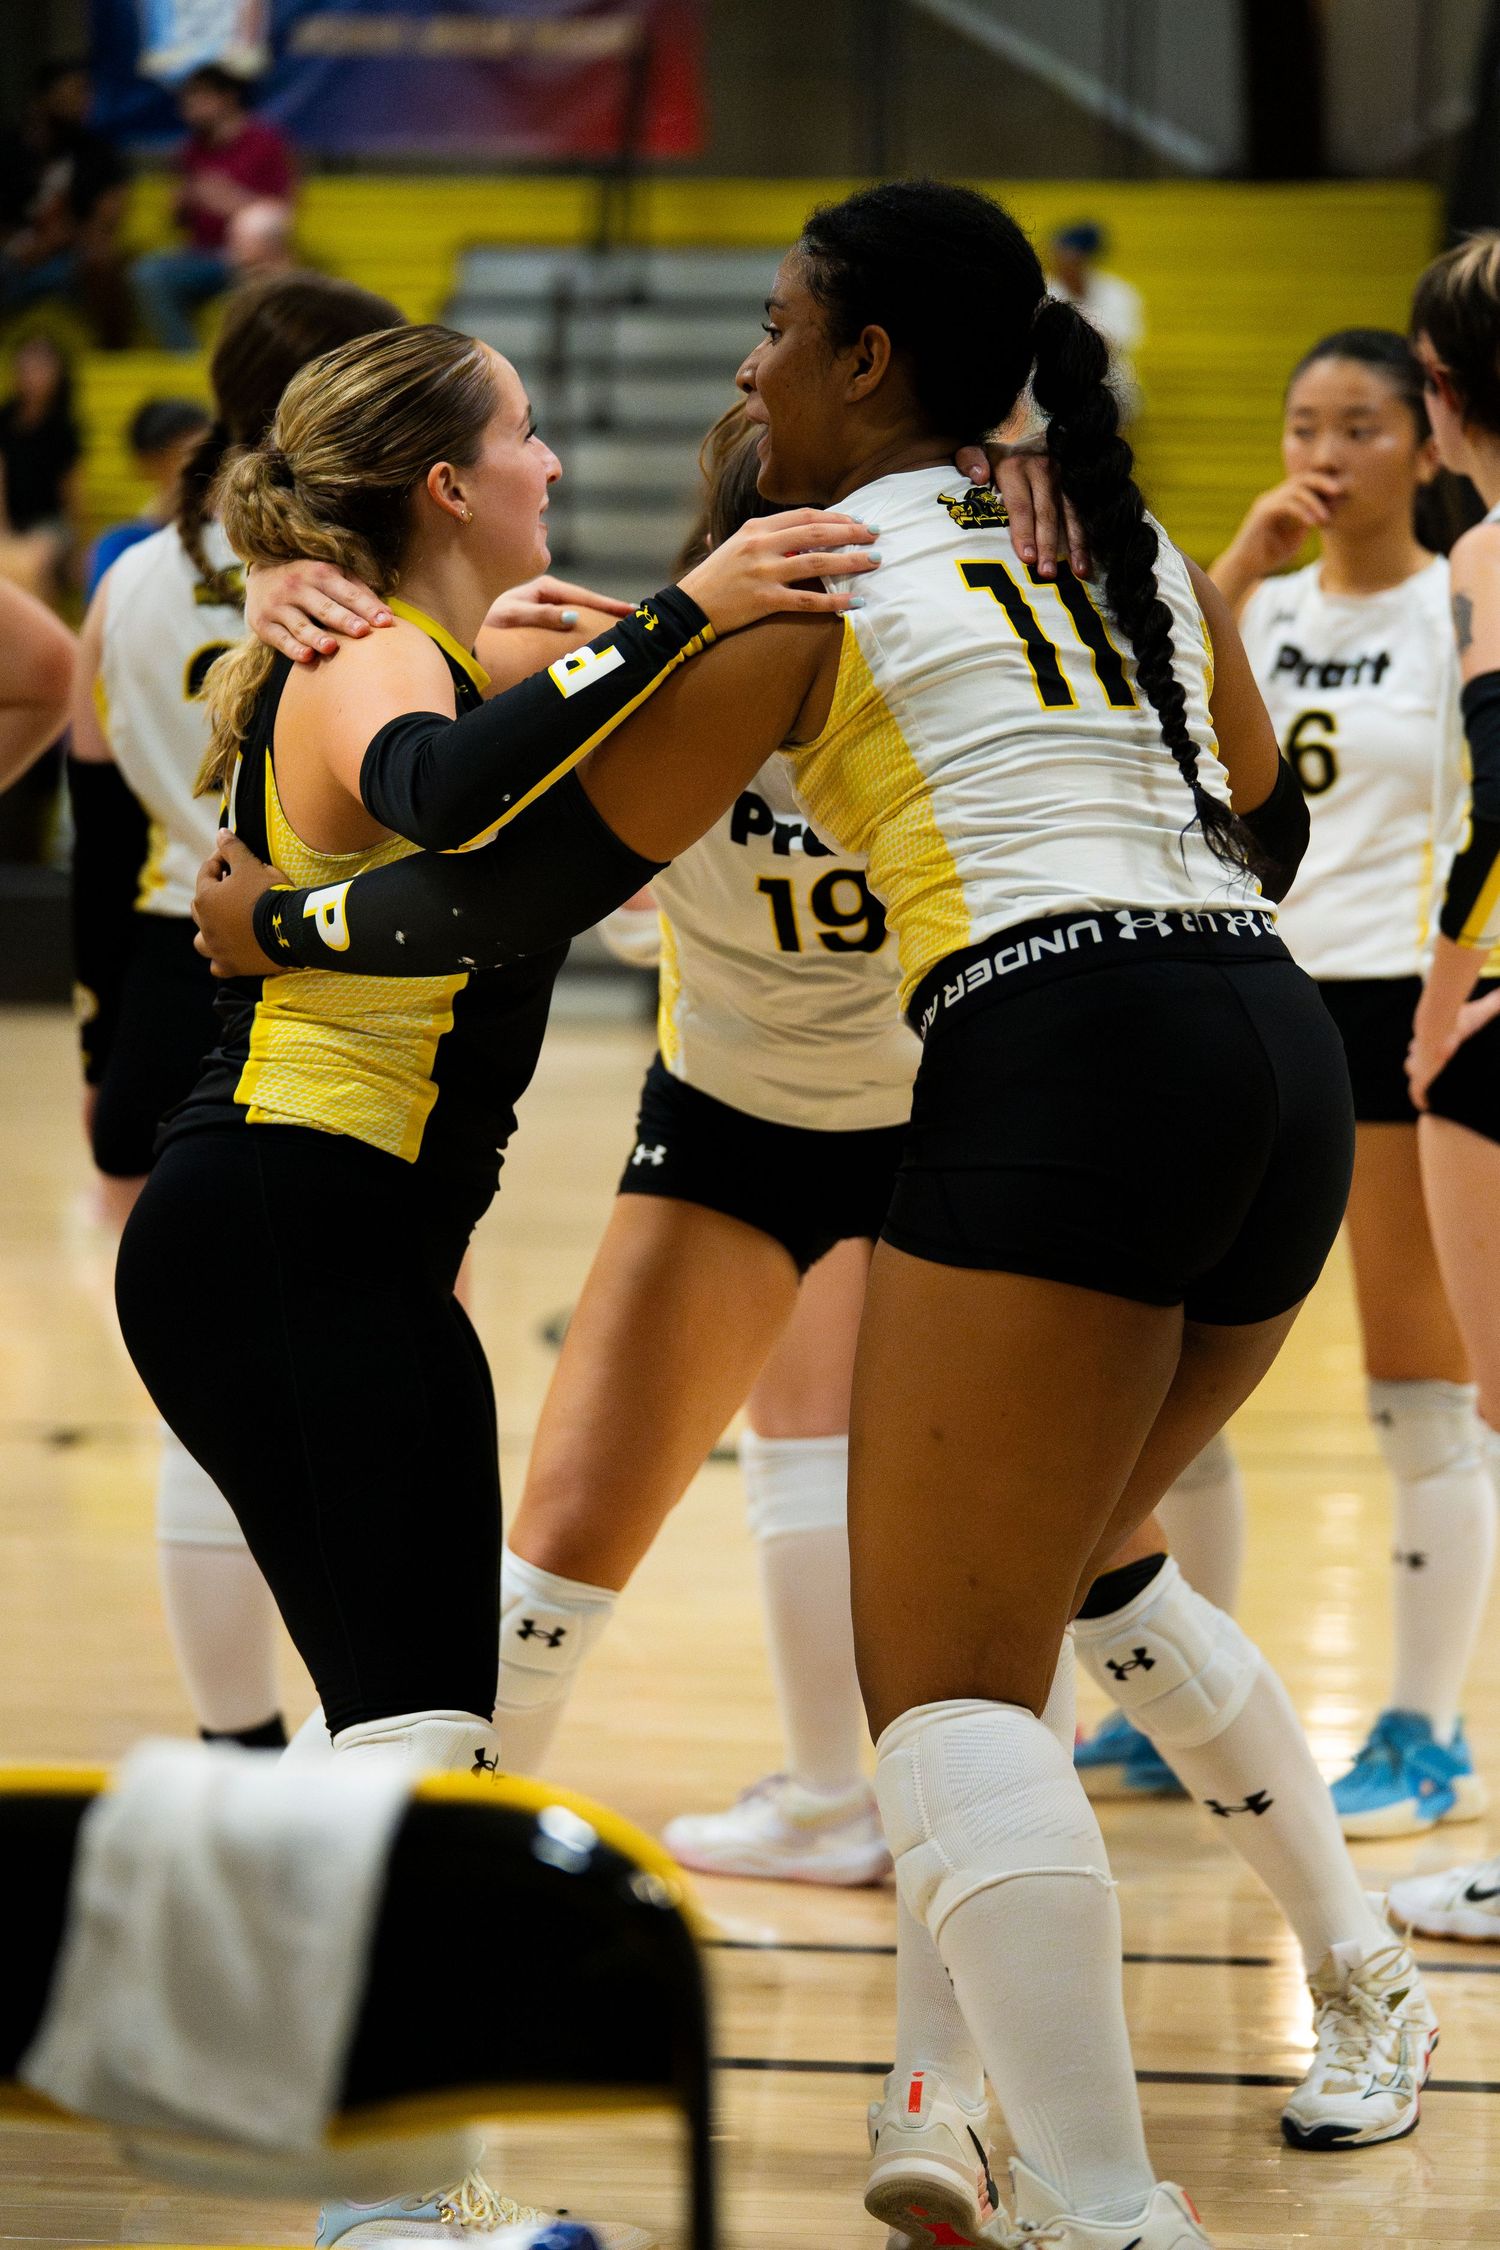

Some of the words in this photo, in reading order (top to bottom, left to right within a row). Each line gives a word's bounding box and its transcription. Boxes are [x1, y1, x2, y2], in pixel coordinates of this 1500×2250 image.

[547, 645, 626, 699] P
[956, 559, 1139, 711] 11
[1269, 643, 1391, 689] Pratt
[1285, 708, 1339, 796] 6
[303, 879, 355, 952] P
[755, 868, 889, 954] 19
[944, 917, 1104, 1008] UNDER
